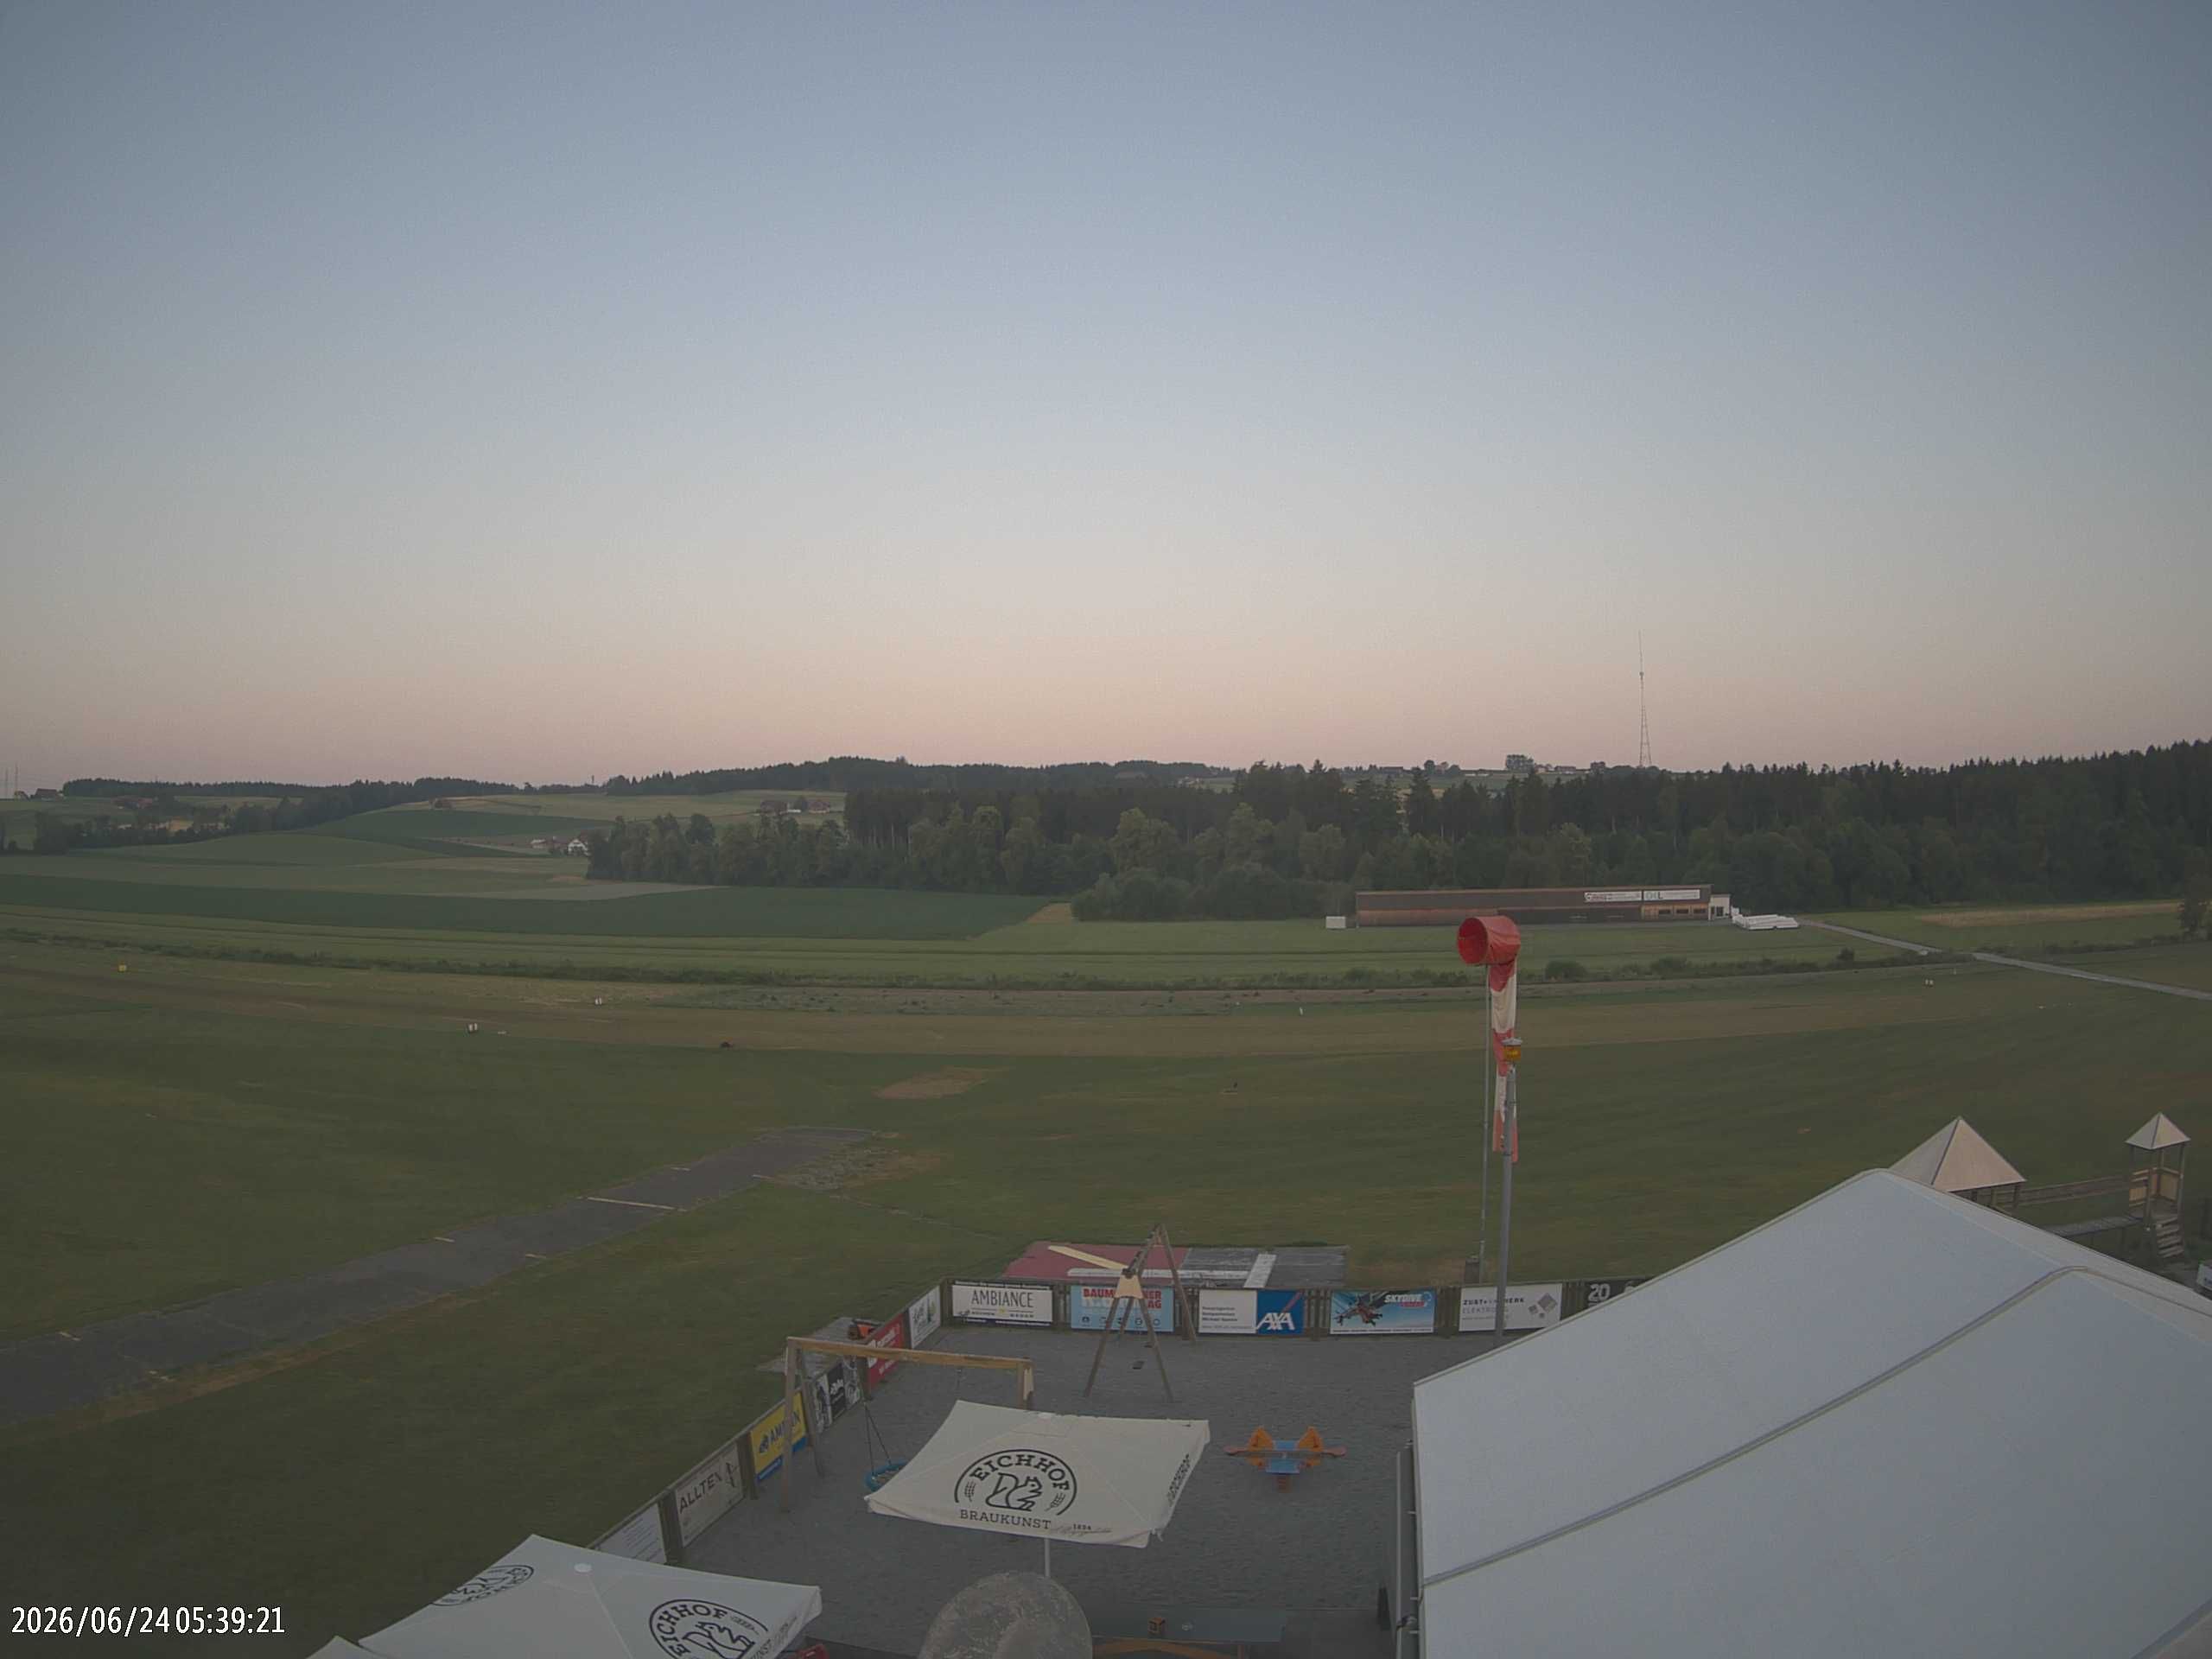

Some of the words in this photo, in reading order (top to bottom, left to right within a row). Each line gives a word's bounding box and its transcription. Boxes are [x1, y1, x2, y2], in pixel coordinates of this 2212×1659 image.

[971, 1289, 1034, 1308] AMBIANCE
[1256, 1313, 1295, 1330] AXA
[969, 1454, 1070, 1491] EICHHOF
[960, 1509, 1052, 1529] BRAUKUNST
[657, 1604, 728, 1656] EICHHOF
